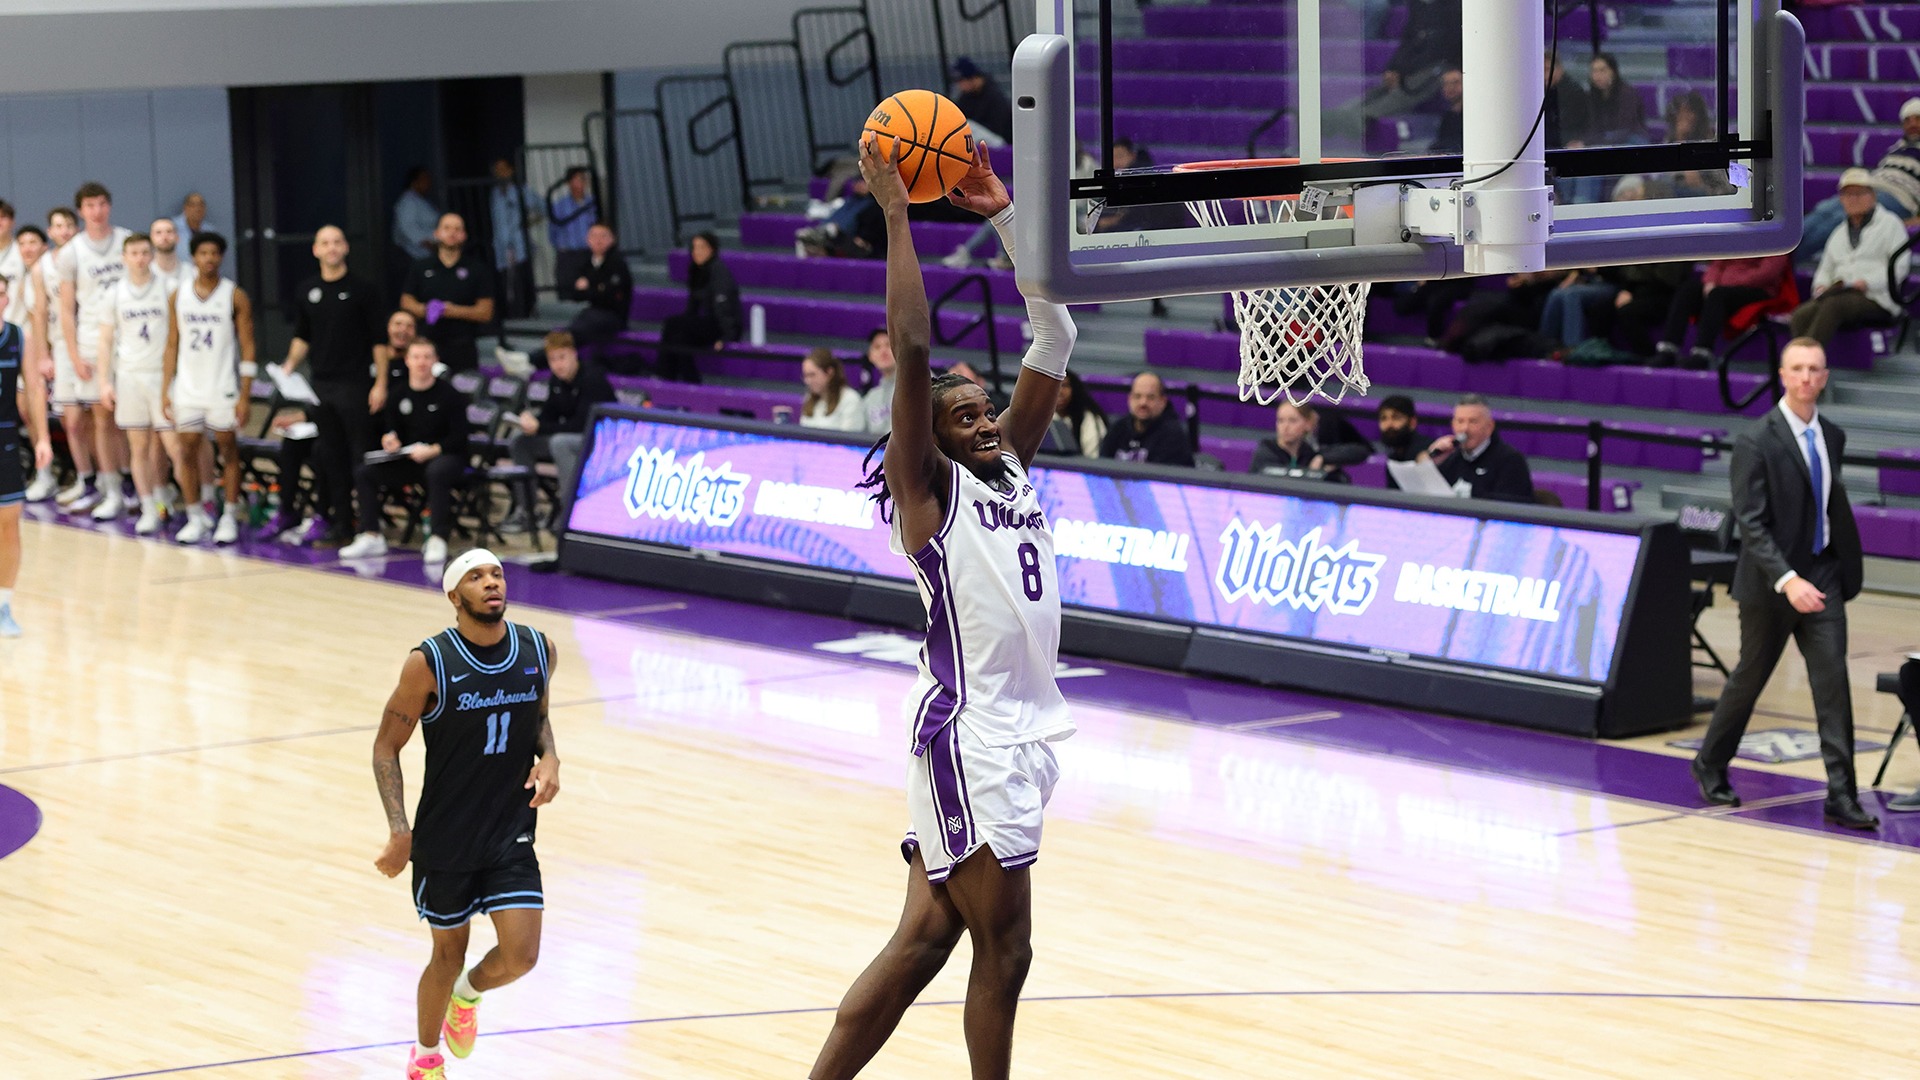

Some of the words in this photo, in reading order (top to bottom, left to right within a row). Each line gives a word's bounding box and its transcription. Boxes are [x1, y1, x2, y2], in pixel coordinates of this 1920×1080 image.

[189, 328, 213, 350] 24
[623, 445, 752, 527] Violets
[1017, 543, 1043, 602] 8
[1215, 518, 1387, 615] Violets
[1394, 562, 1561, 622] BASKETBALL
[456, 685, 538, 711] Bloodhounds
[483, 711, 511, 755] 11
